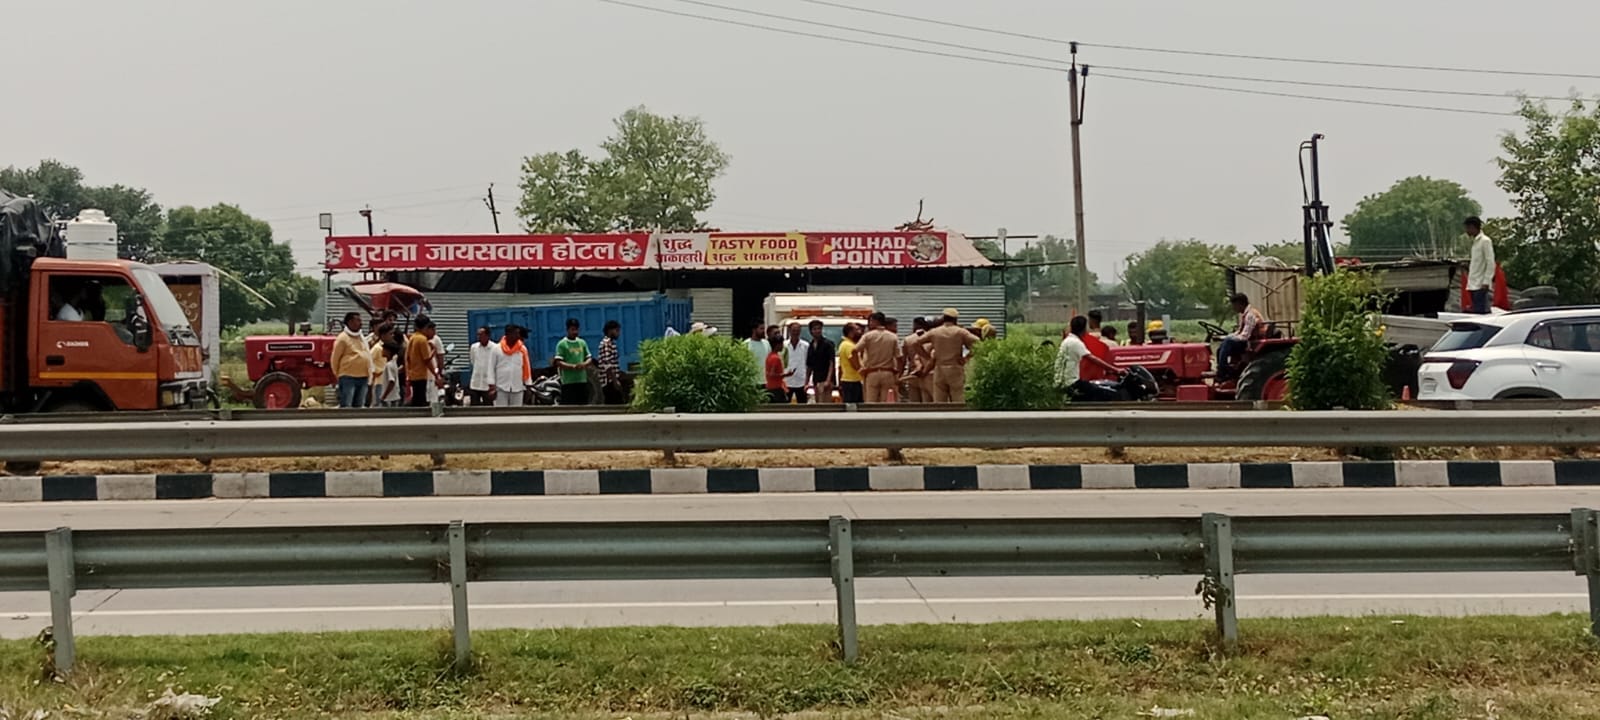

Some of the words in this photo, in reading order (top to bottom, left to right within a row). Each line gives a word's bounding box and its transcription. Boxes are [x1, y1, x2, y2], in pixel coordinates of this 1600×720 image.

[710, 239, 755, 249] TASTY
[760, 239, 797, 249] FOOD
[831, 236, 906, 250] KULHAD
[348, 243, 417, 268] पुराना
[425, 242, 543, 262] जायसवाल
[550, 236, 616, 261] होटल
[831, 250, 905, 264] POINT
